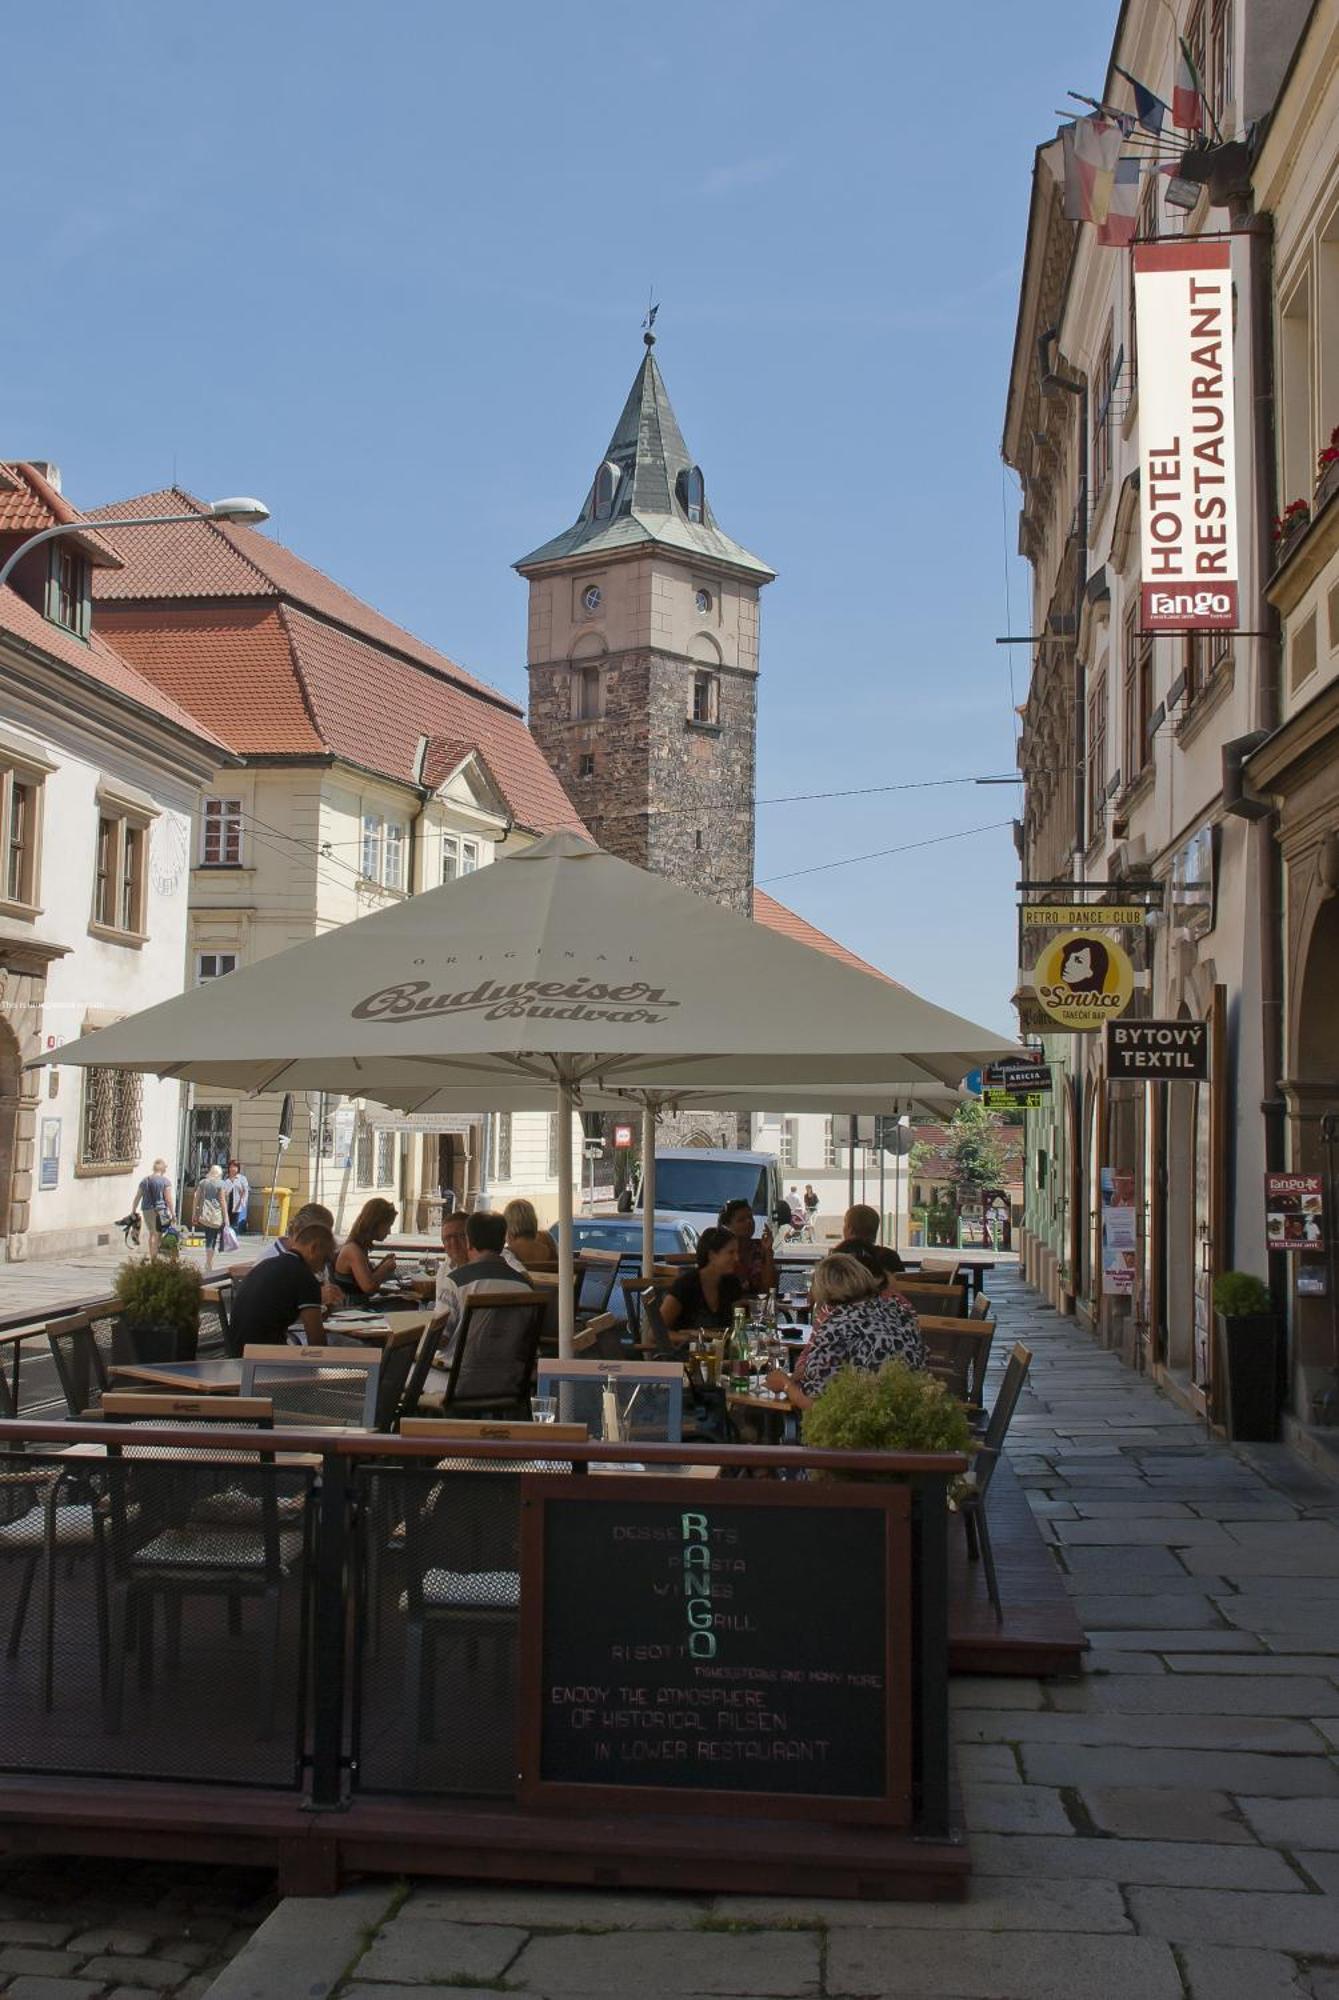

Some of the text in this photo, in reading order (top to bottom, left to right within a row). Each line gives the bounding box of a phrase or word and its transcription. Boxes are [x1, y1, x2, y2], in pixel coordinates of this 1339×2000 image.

[1189, 277, 1228, 575] RESTAURANT
[1150, 436, 1184, 576] HOTEL
[1150, 592, 1231, 616] rango
[1025, 910, 1141, 924] RETRO DANCE CLUB
[413, 948, 639, 965] ORIGINAL
[350, 976, 681, 1024] Budweiser
[1046, 985, 1121, 1009] Source
[484, 996, 670, 1024] Budvar
[1114, 1025, 1202, 1047] BYTOVÝ
[1121, 1051, 1196, 1069] TEXTIL
[551, 1686, 768, 1708] ENJOY THE ATMOSPHERE
[571, 1708, 787, 1731] OF HISTORICAL PILSEN
[595, 1739, 831, 1761] IN LOWER RESTAURANT
